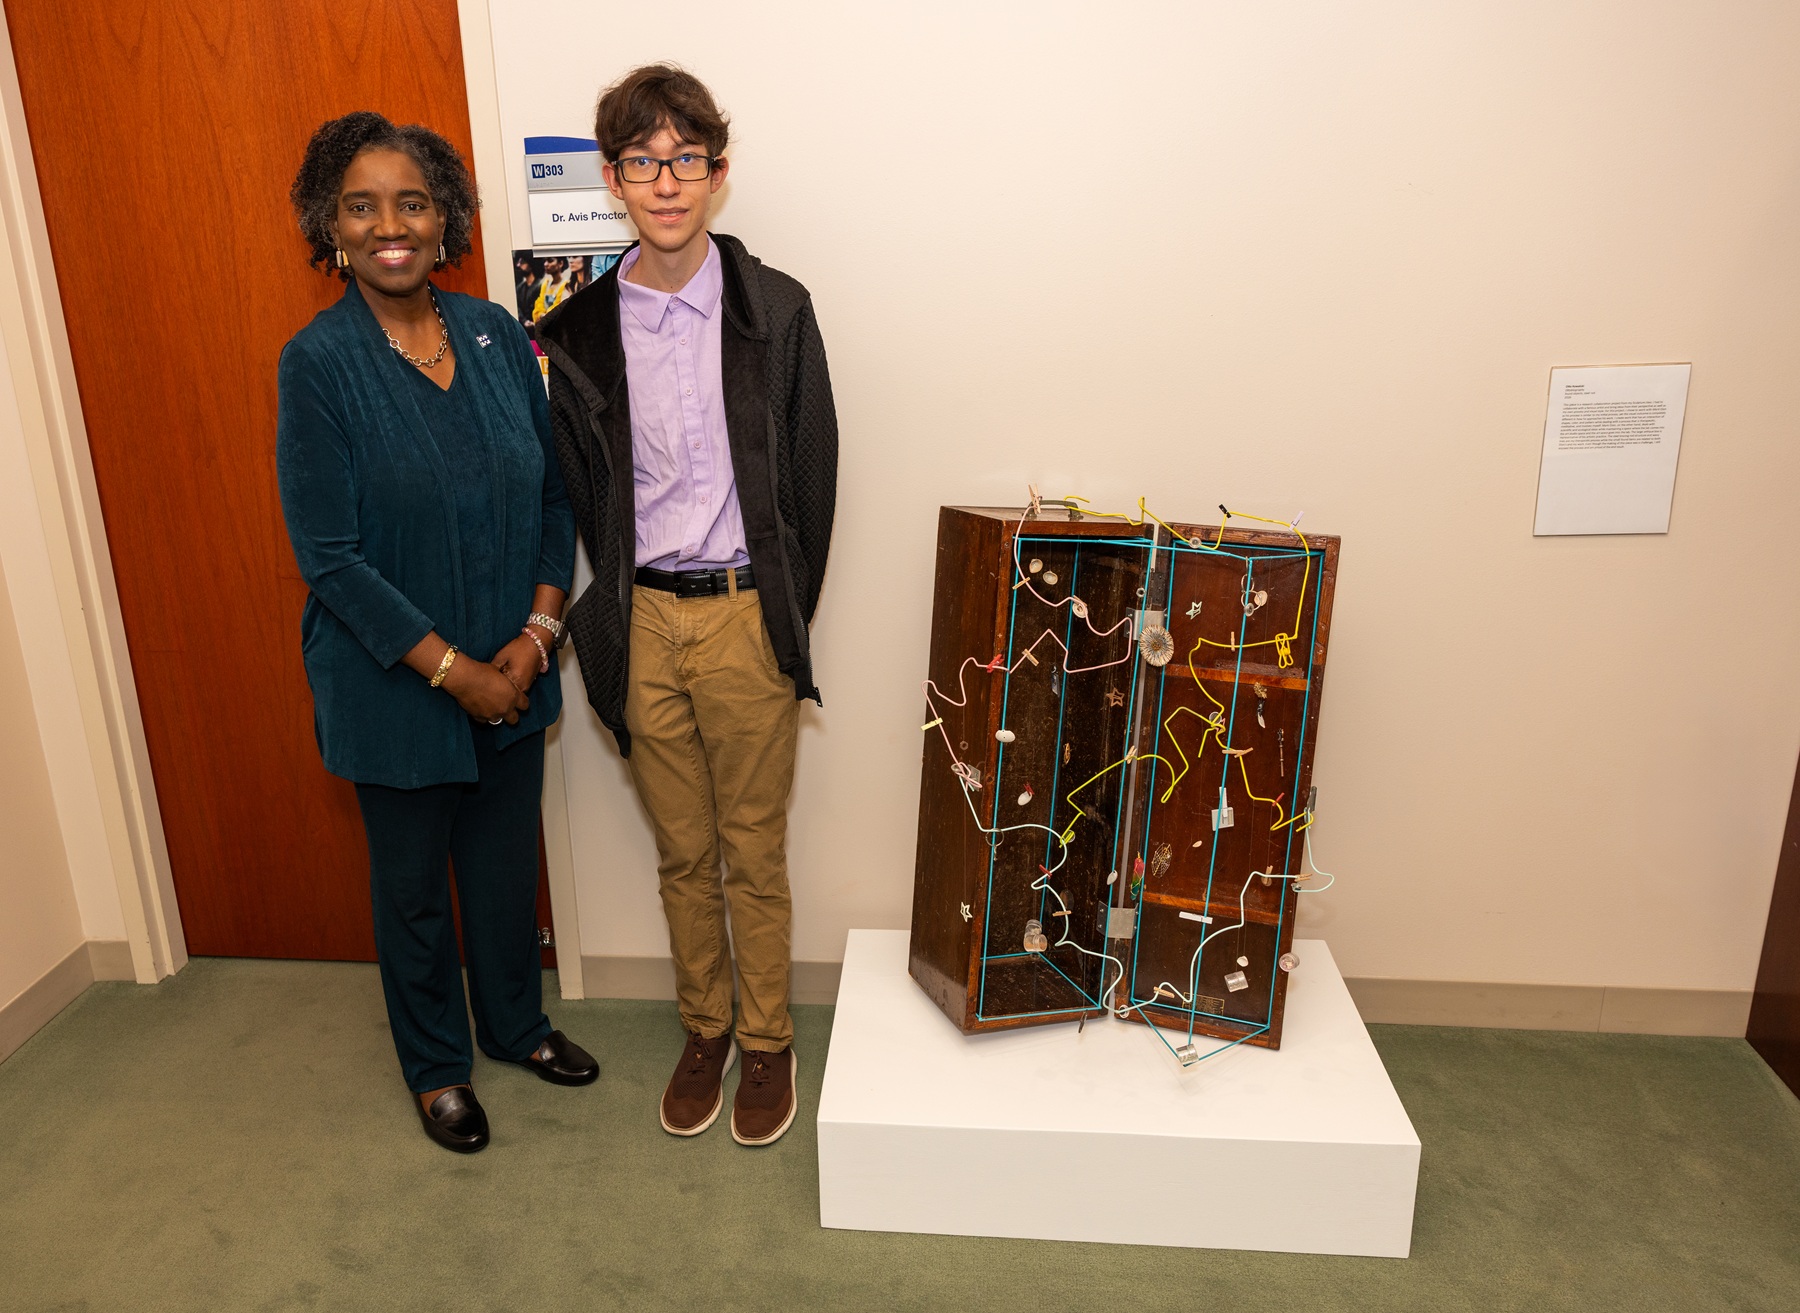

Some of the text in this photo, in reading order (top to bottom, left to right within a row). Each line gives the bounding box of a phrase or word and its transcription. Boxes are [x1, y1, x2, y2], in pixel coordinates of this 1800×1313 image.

[532, 164, 563, 178] W303
[552, 211, 628, 222] Dr. Avis Proctor
